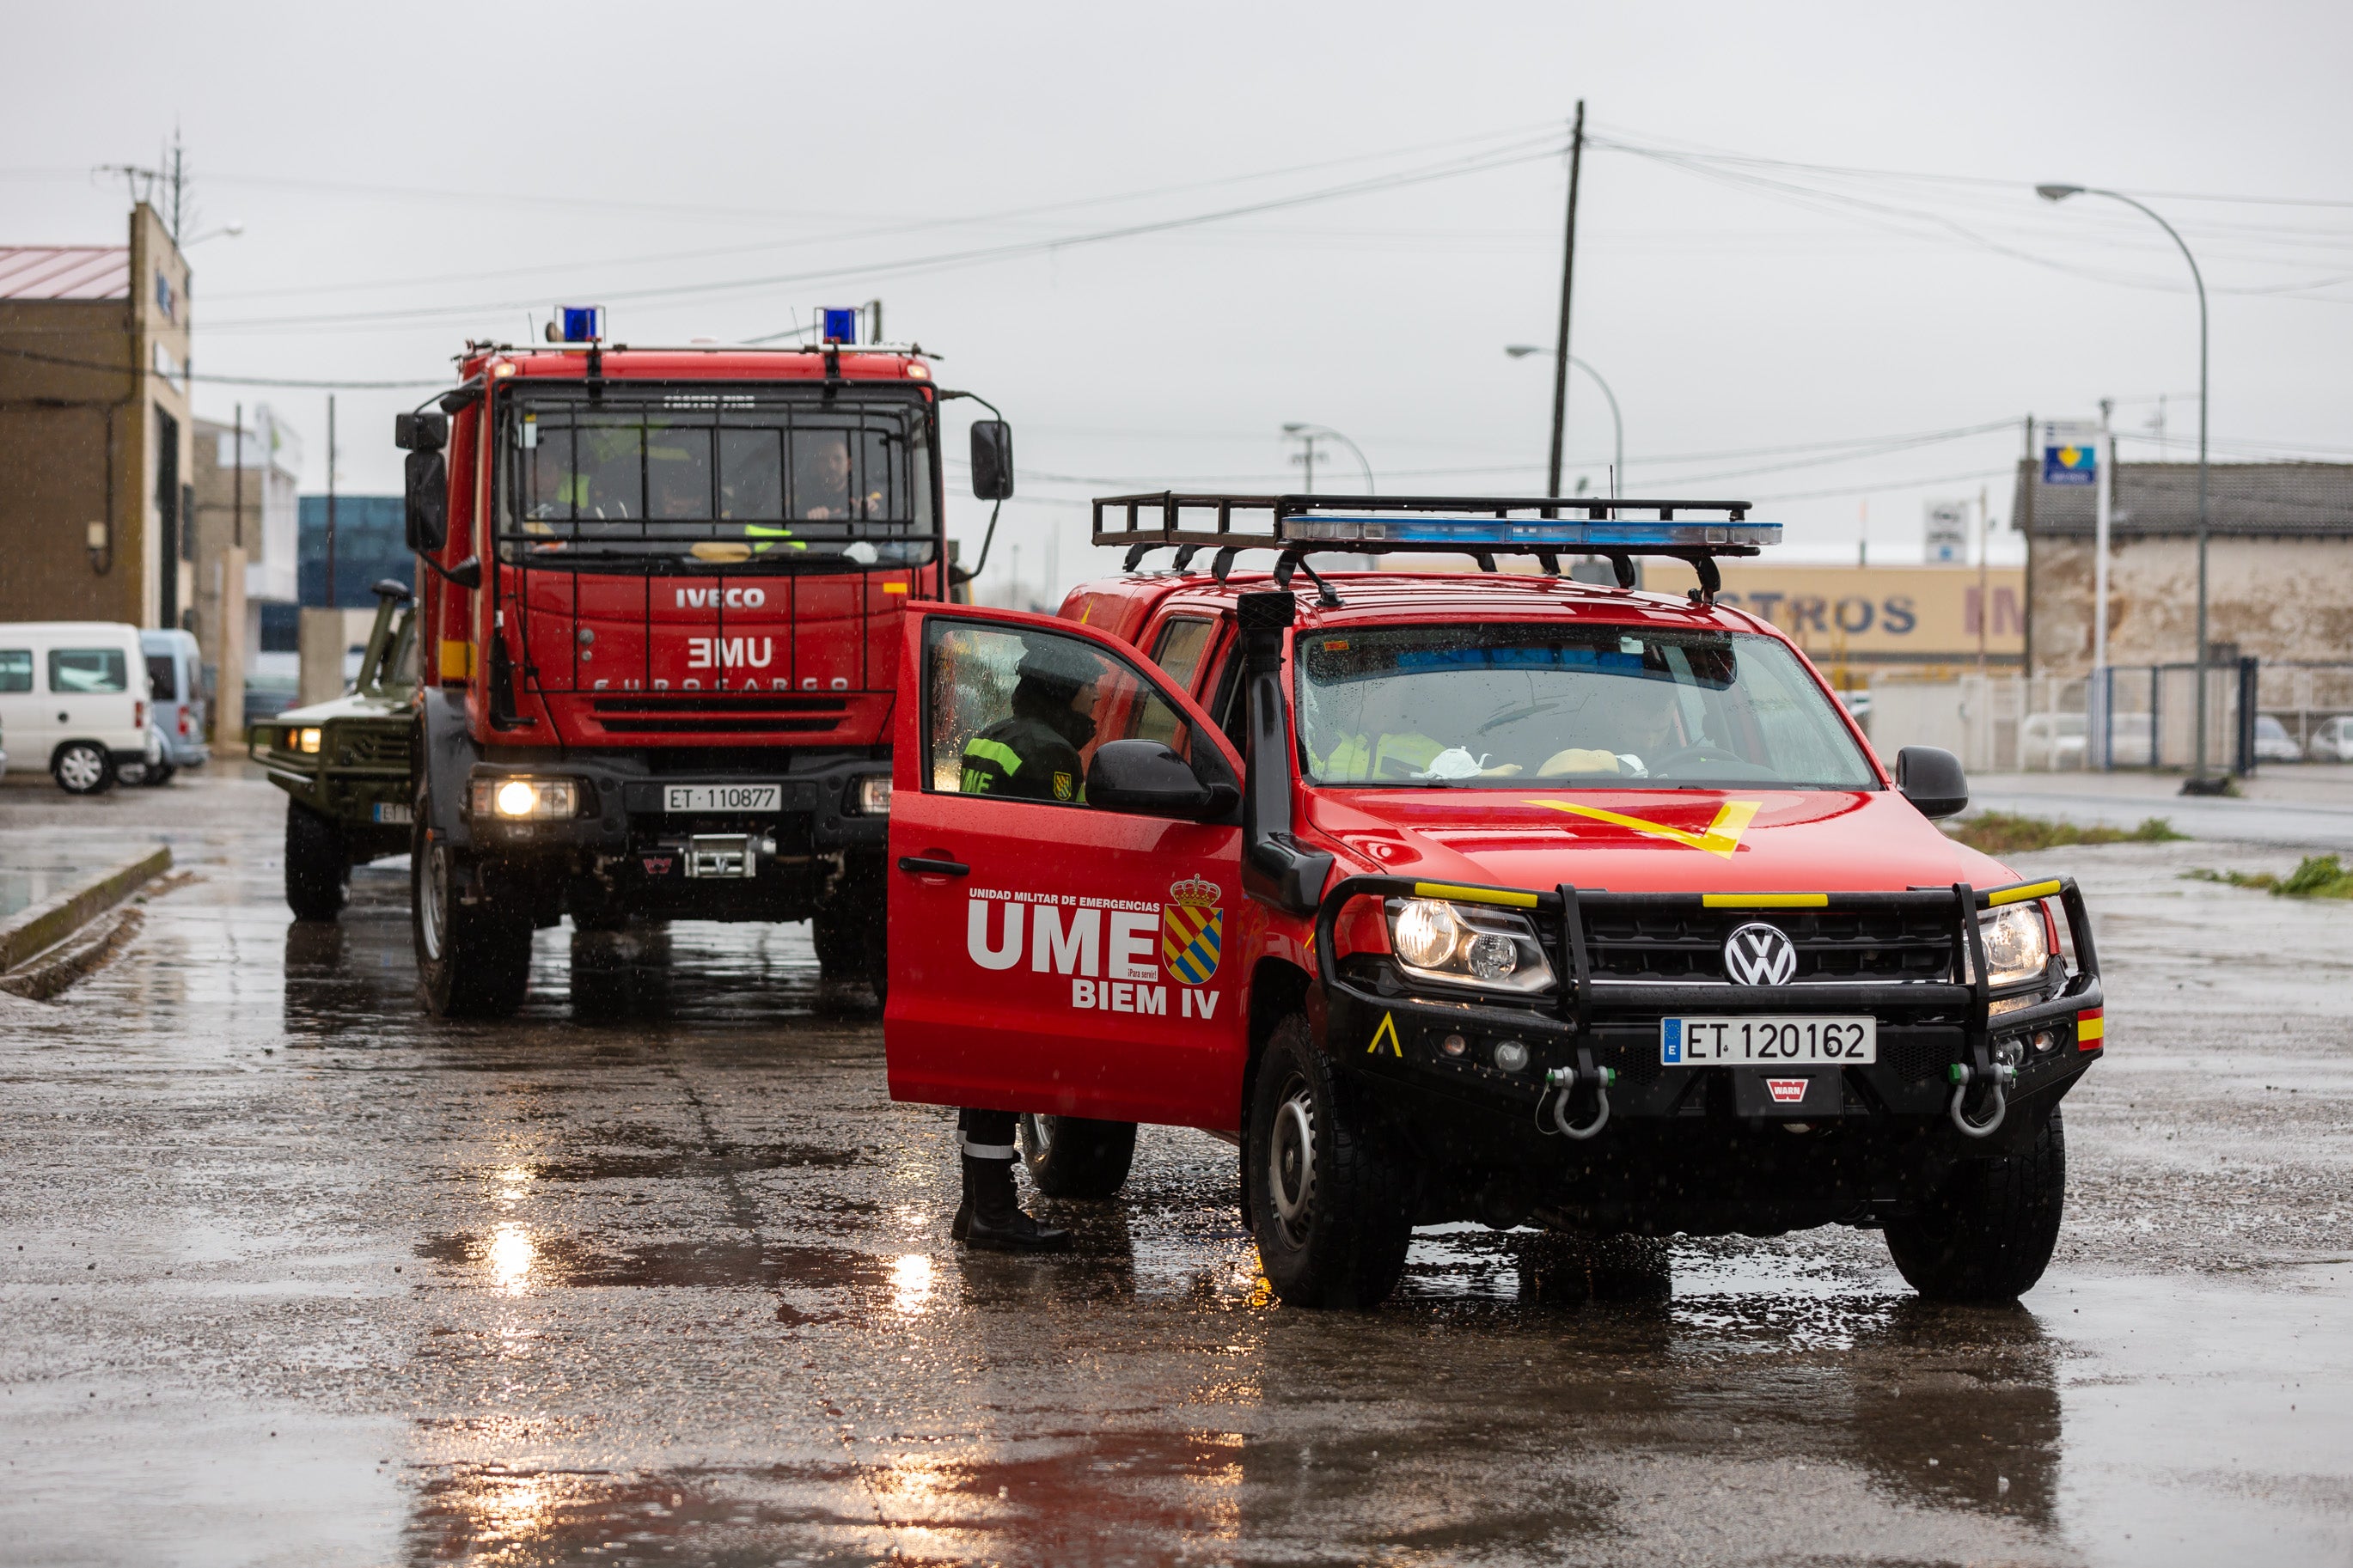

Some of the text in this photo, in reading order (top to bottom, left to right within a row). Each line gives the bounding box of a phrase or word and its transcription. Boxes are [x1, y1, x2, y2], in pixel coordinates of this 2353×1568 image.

[675, 588, 765, 608] IVECO
[669, 788, 776, 808] ET 110877
[969, 888, 1160, 912] UNIDAD MILITAR DE EMERGENCIAS
[967, 899, 1160, 982] UME
[1072, 978, 1220, 1020] BIEM IV
[1687, 1023, 1865, 1059] ET 120162
[1774, 1086, 1801, 1095] WARN
